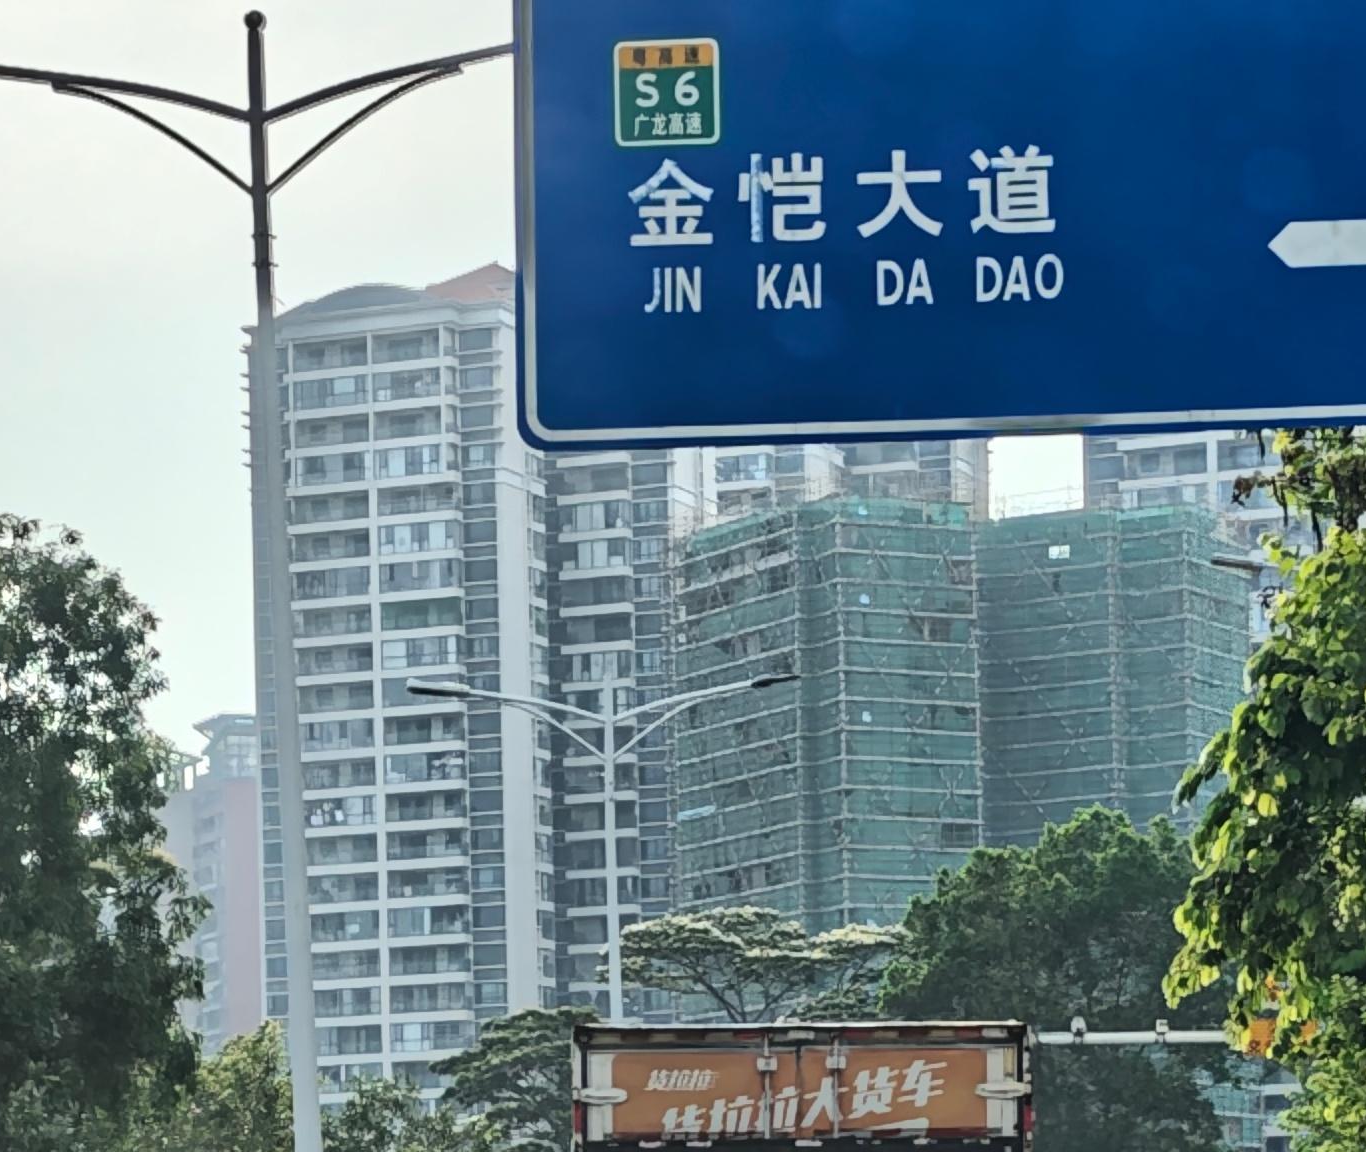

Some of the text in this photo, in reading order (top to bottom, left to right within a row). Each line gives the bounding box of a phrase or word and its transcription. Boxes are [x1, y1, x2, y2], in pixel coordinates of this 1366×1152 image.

[635, 71, 700, 108] S6
[634, 112, 703, 137] 广龙高速
[628, 145, 1057, 247] 金恺大道
[644, 253, 1064, 313] JIN KAI DA DAO
